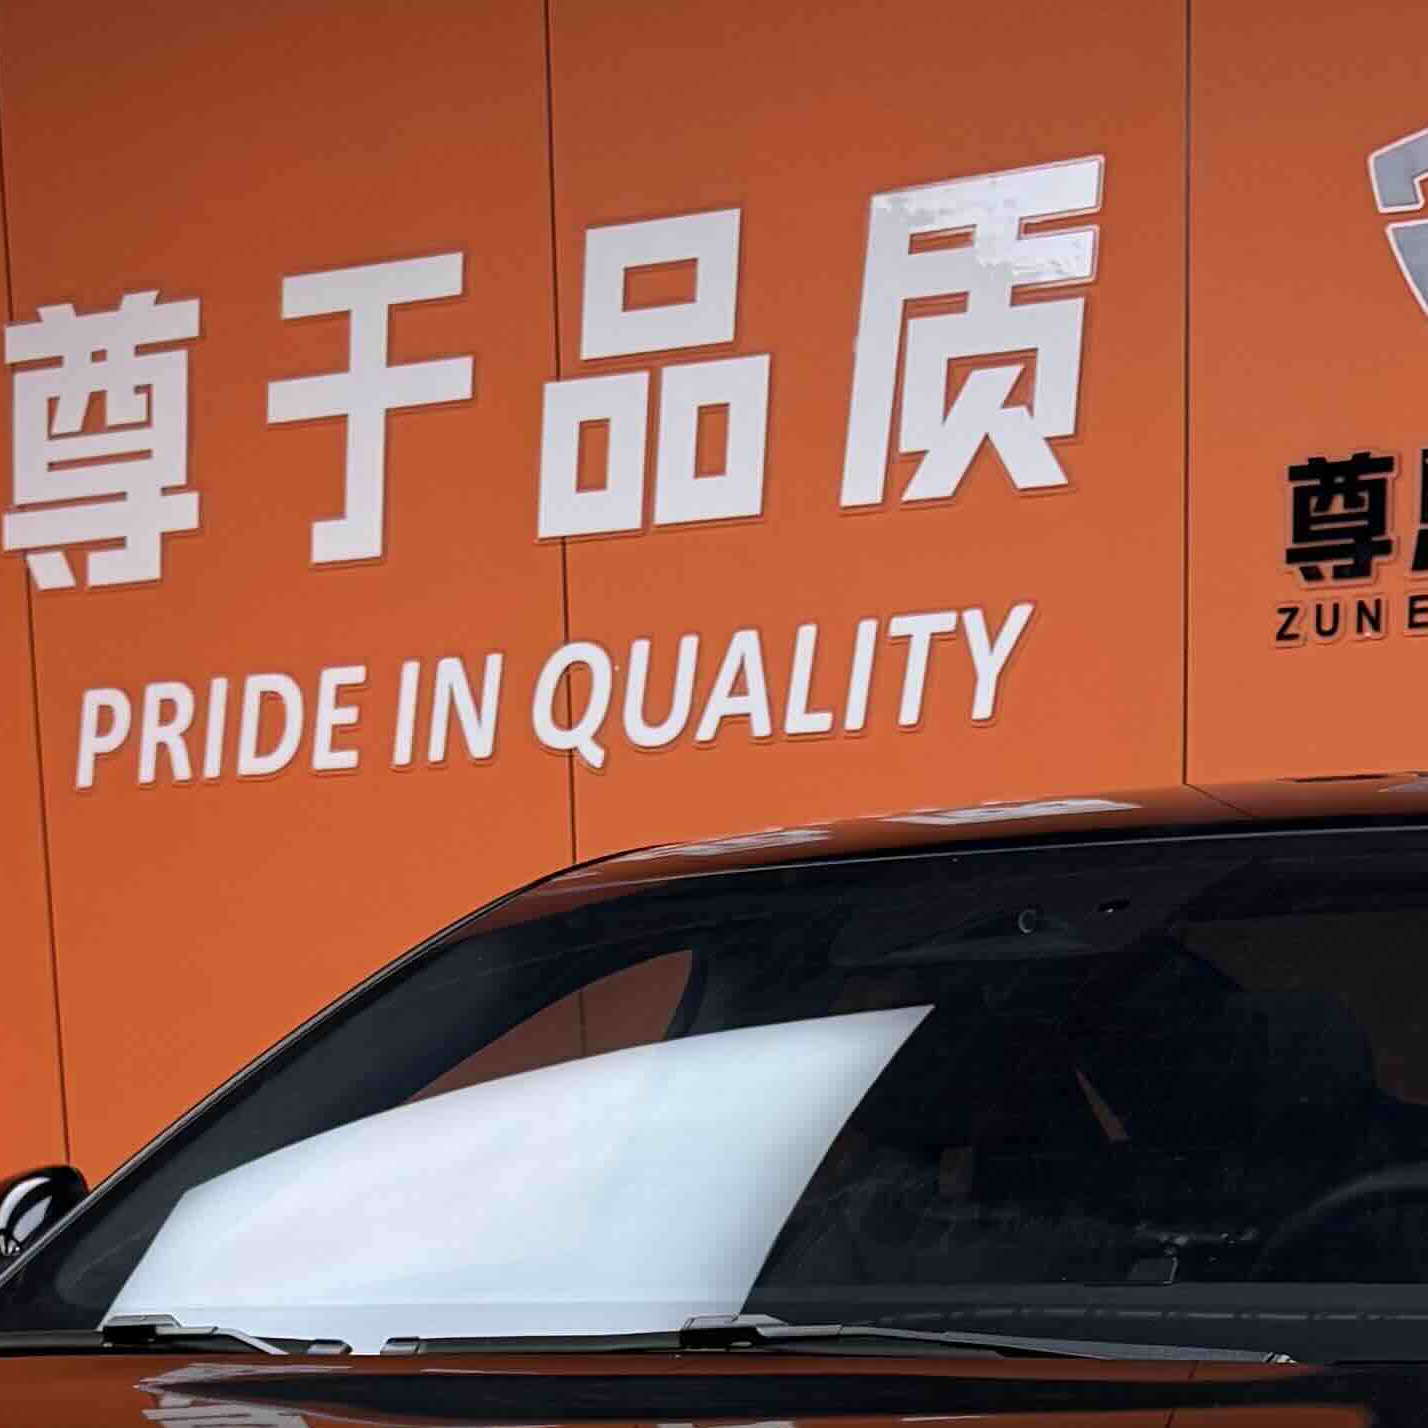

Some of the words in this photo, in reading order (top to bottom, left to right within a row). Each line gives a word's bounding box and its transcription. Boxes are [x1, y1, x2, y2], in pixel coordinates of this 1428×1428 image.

[2, 155, 1105, 590] 尊于品质
[76, 665, 366, 788] PRIDE
[393, 653, 503, 765] IN
[532, 603, 1034, 768] QUALITY
